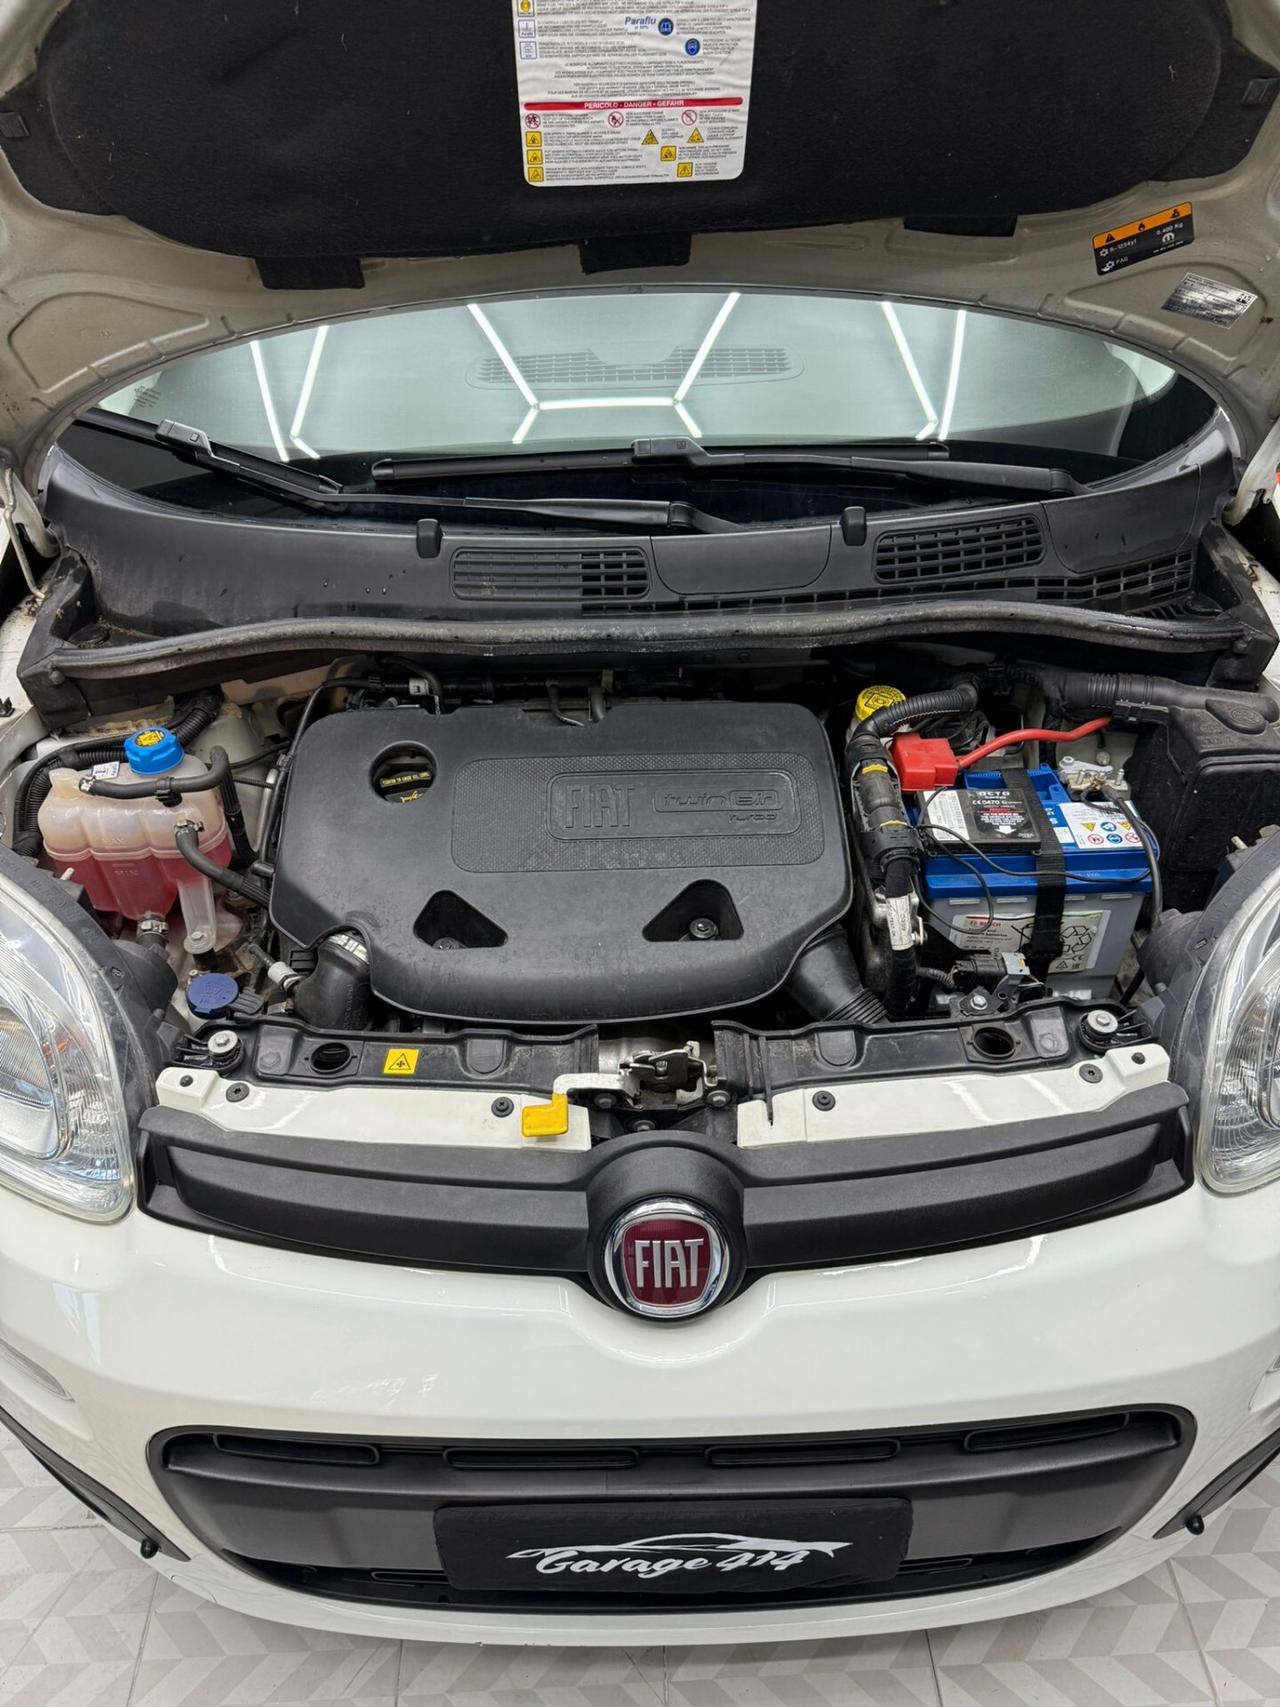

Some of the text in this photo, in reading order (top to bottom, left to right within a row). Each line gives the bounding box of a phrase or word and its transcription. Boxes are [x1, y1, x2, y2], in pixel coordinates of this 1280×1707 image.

[625, 16, 656, 26] Paraflu
[584, 101, 619, 109] PERICOLO
[656, 99, 685, 107] GEFAHR
[564, 784, 635, 829] FIAT
[634, 1238, 704, 1288] FIAT
[536, 1550, 810, 1579] Garage 414
